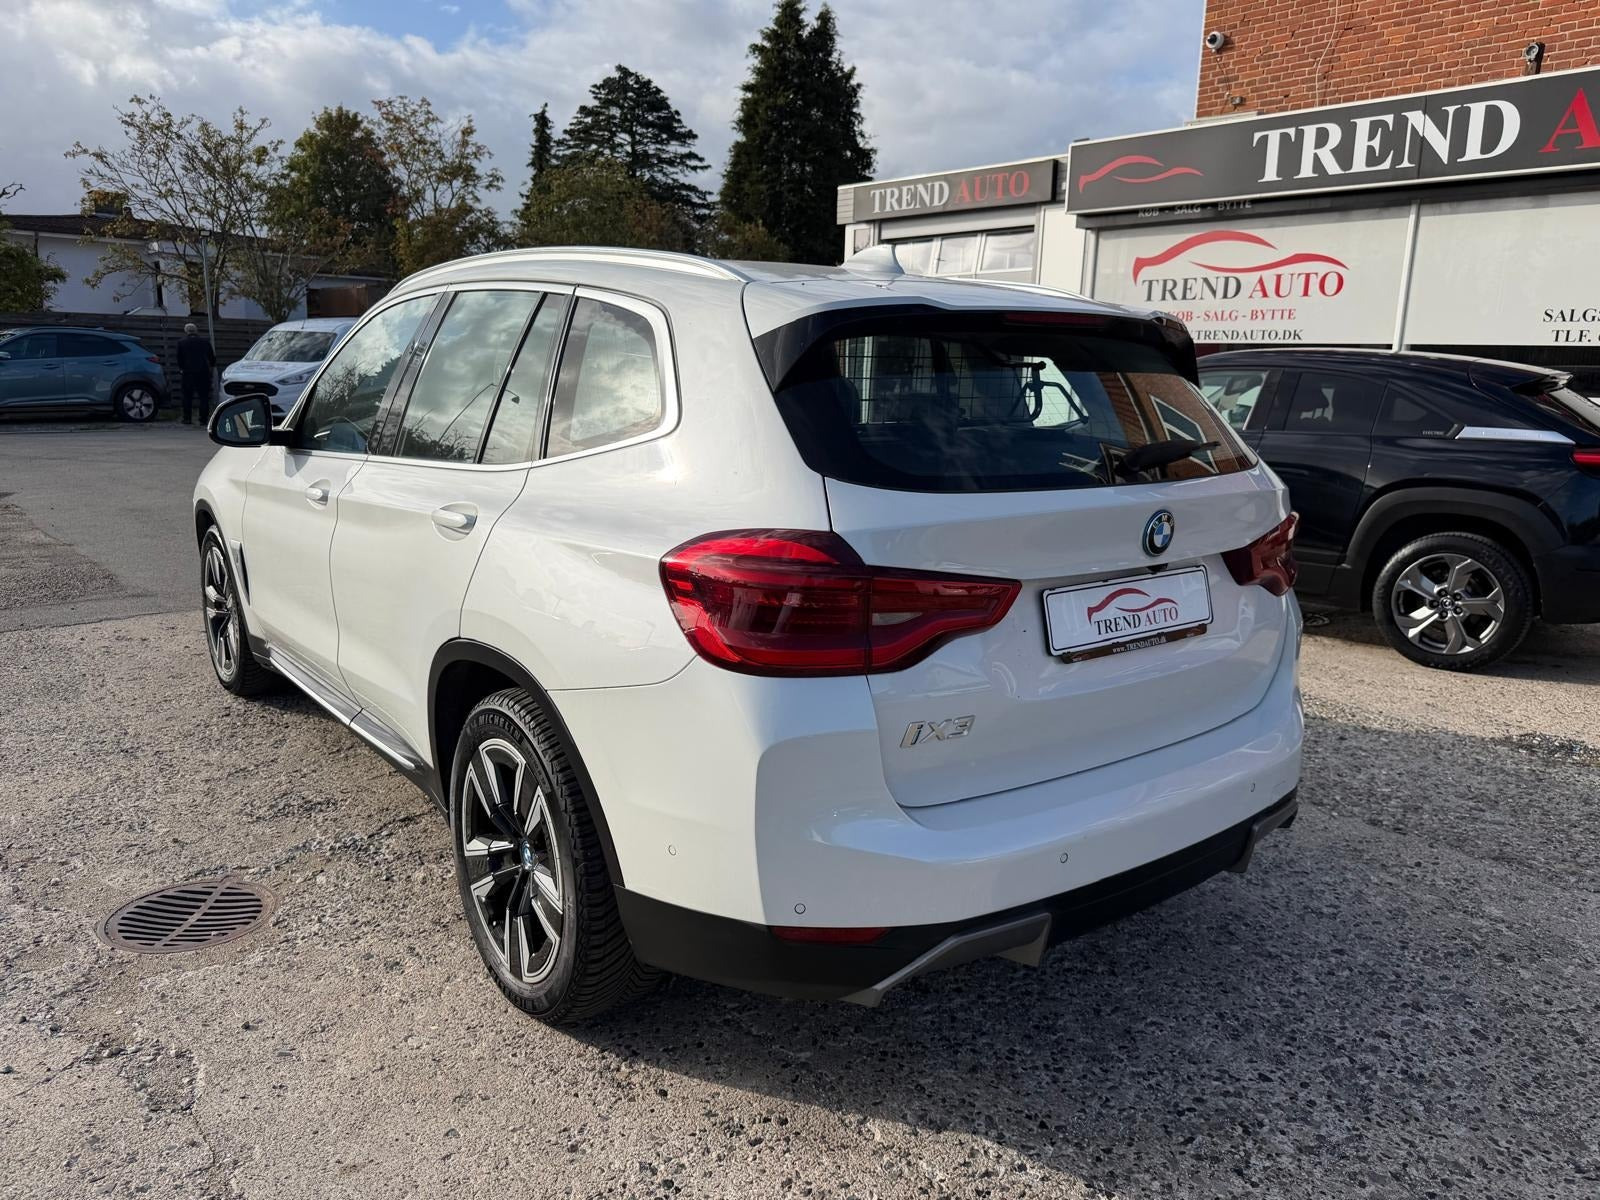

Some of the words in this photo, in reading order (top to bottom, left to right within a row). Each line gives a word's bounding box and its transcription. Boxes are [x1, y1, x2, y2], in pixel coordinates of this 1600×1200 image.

[1252, 99, 1521, 184] TREND
[870, 180, 950, 214] TREND
[954, 170, 1031, 205] AUTO
[1142, 274, 1243, 303] TREND
[1247, 270, 1345, 299] AUTO
[1203, 309, 1239, 322] SALG
[1249, 308, 1297, 321] BYTTE
[1543, 307, 1600, 323] SALG
[1191, 328, 1304, 341] TRENDAUTO.DK
[1551, 329, 1592, 343] TLF.
[1094, 613, 1142, 636] TREND
[1144, 606, 1179, 626] AUTO
[478, 713, 521, 742] MICHELIN
